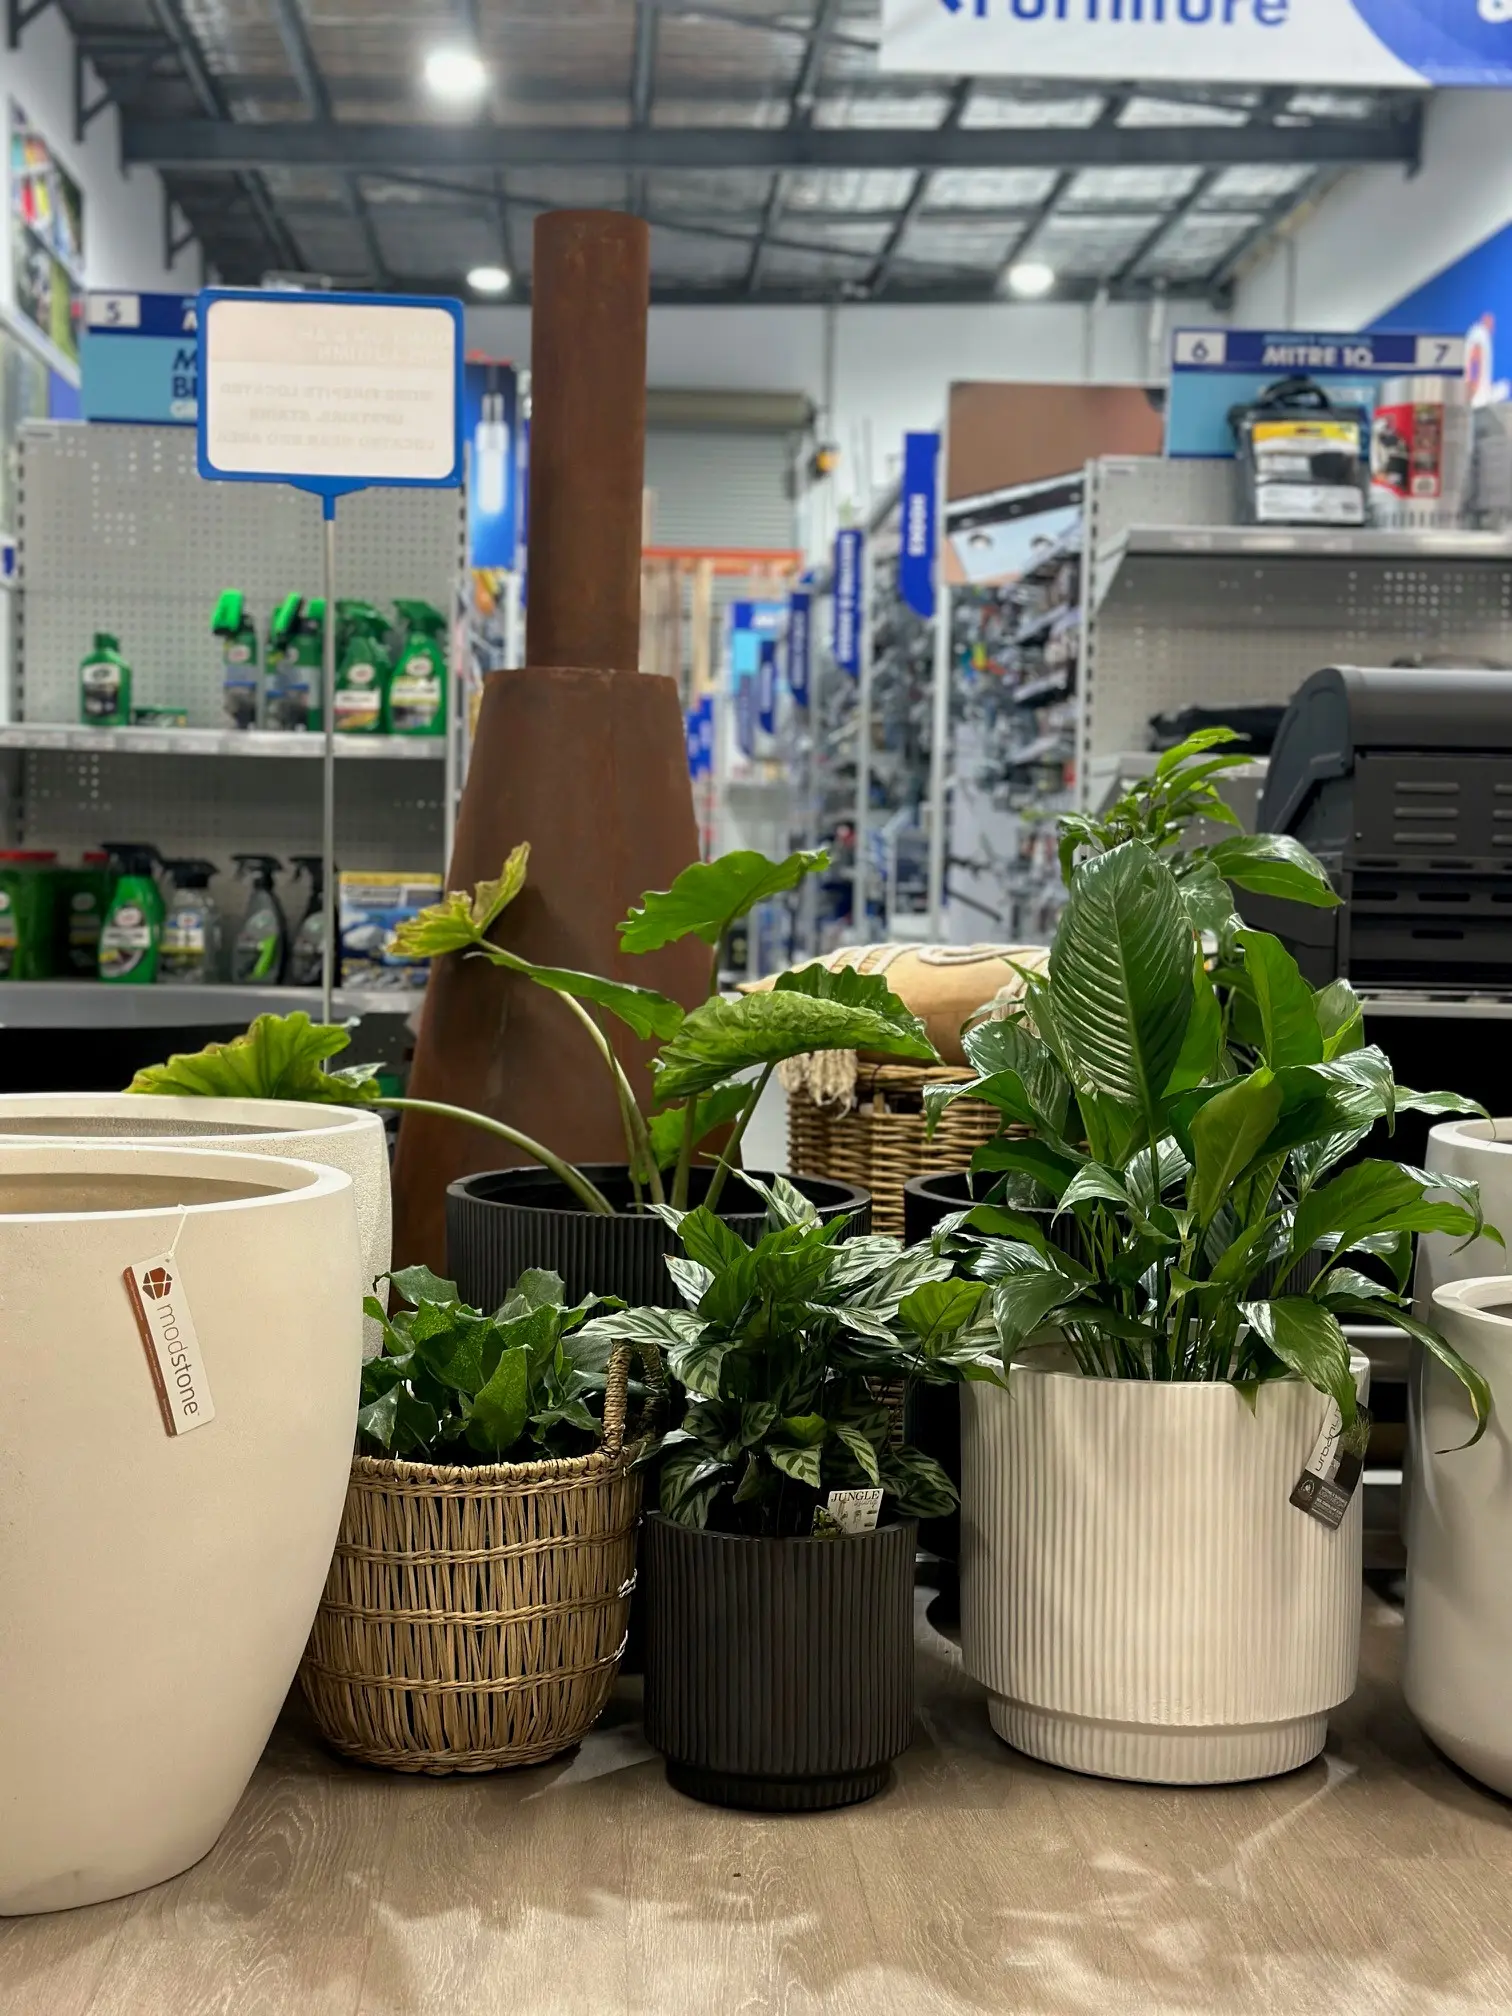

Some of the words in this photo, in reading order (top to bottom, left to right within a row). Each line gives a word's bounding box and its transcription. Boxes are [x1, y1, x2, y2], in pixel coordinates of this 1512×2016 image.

[1191, 338, 1209, 362] 6
[1262, 346, 1338, 367] MITRE
[1343, 346, 1375, 368] 10
[1434, 344, 1450, 361] 7
[157, 1303, 199, 1416] modstone
[831, 1490, 880, 1502] JUNGLE
